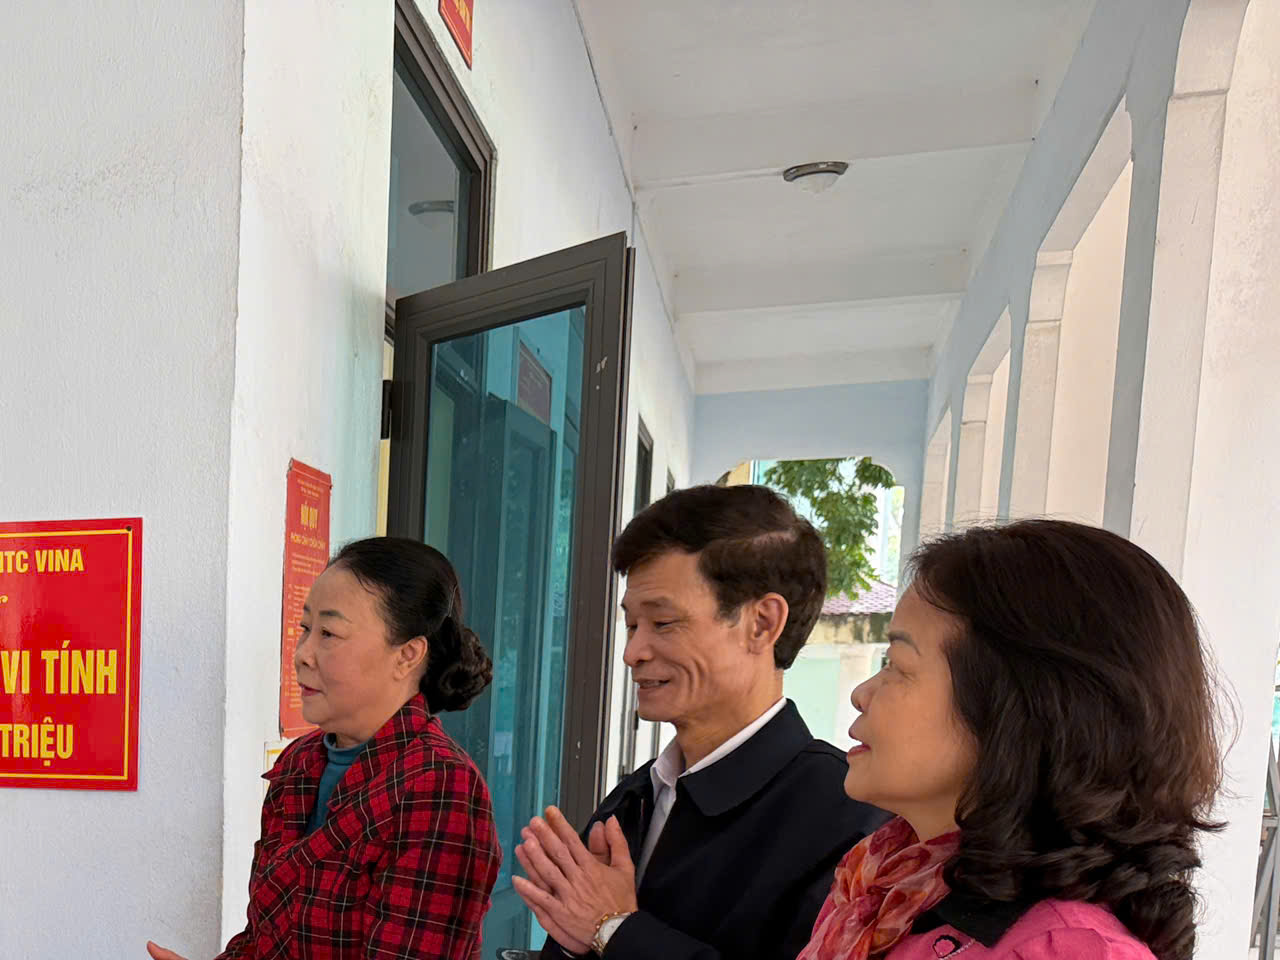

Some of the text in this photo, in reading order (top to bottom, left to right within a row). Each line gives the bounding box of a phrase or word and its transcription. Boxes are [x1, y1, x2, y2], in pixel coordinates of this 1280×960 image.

[35, 548, 84, 572] VINA
[0, 651, 30, 694] VI
[41, 640, 117, 694] TÍNH
